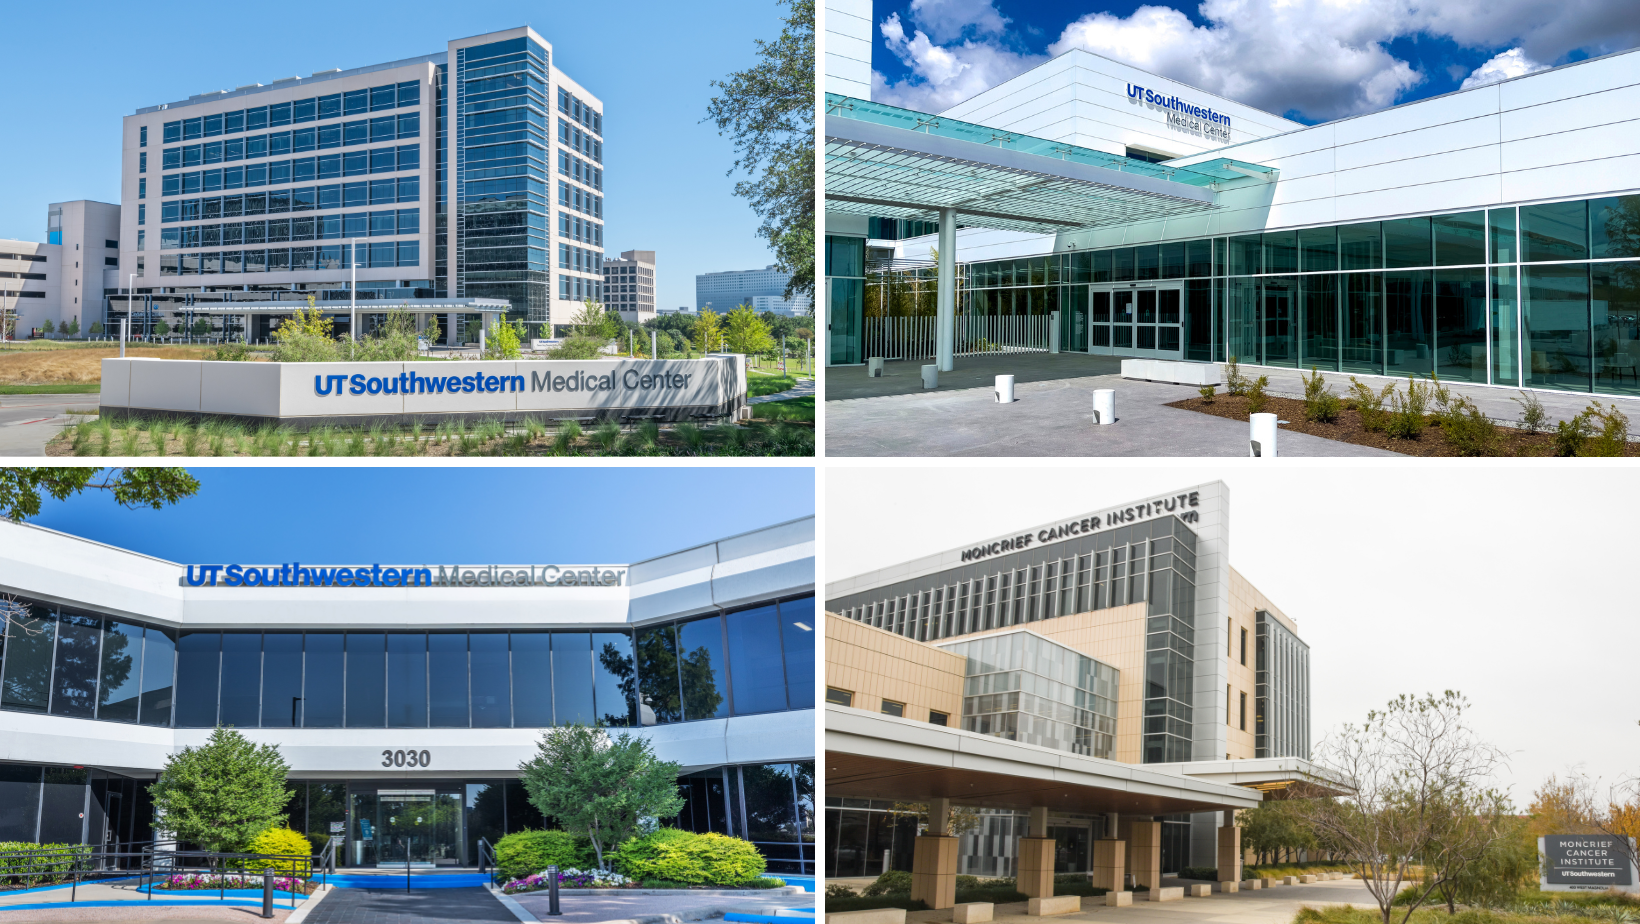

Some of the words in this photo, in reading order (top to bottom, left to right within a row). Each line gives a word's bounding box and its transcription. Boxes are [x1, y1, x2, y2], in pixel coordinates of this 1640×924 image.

[1145, 89, 1231, 127] Southwestern
[1166, 111, 1202, 132] Medical
[1203, 122, 1231, 139] Center
[349, 370, 525, 396] Southwestern
[531, 369, 617, 393] Medical
[623, 368, 693, 391] Center
[960, 532, 1033, 563] MONCRIEF
[1037, 515, 1101, 543] CANCER
[1106, 490, 1200, 526] INSTITUTE
[224, 561, 432, 587] Southwestern
[438, 564, 535, 587] Medical
[541, 564, 627, 587] Center
[381, 749, 431, 768] 3030
[1560, 858, 1615, 866] INSTITUTE
[1566, 849, 1608, 857] CANCER
[1570, 870, 1615, 878] Southwestern
